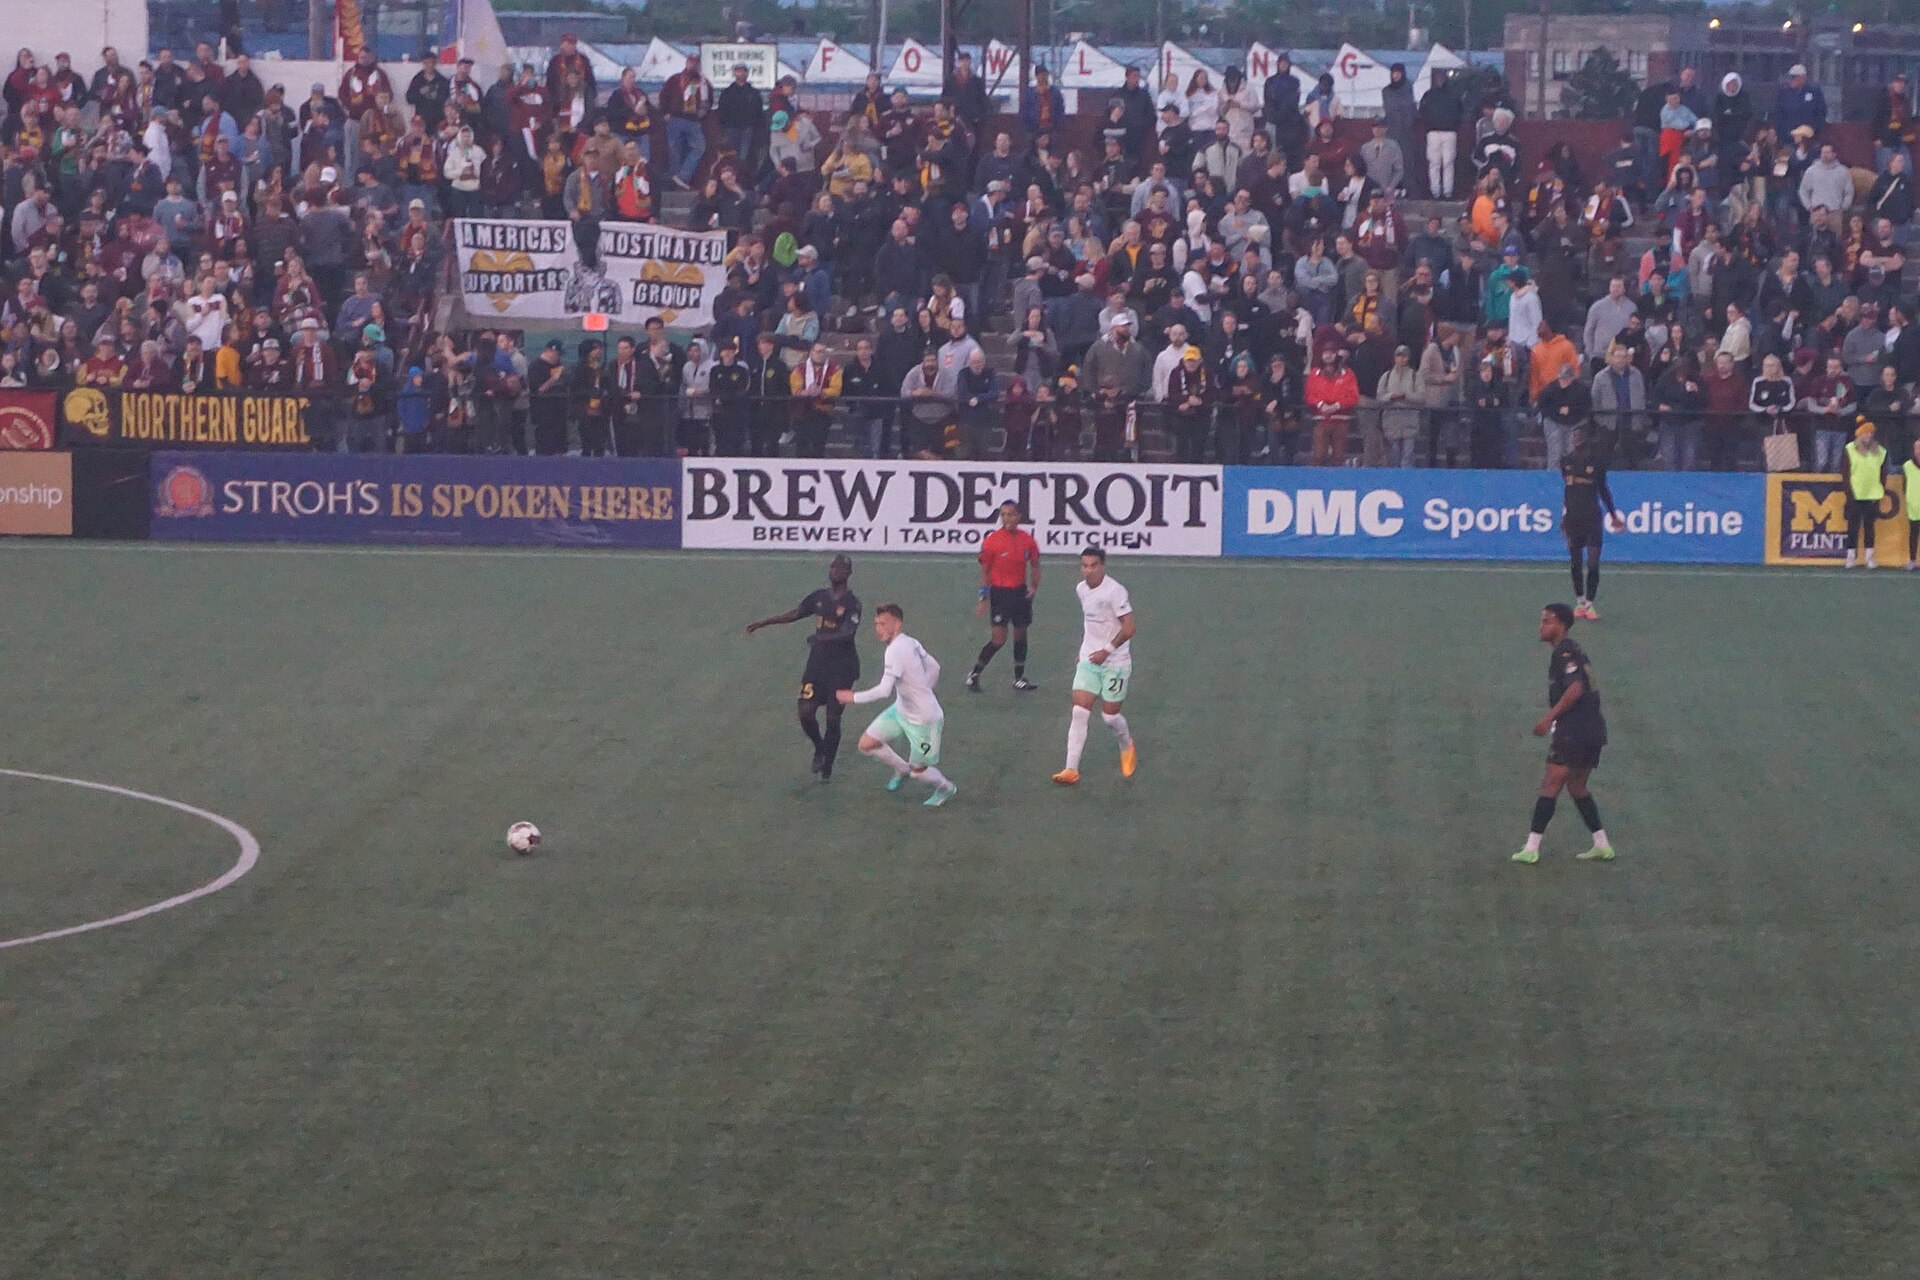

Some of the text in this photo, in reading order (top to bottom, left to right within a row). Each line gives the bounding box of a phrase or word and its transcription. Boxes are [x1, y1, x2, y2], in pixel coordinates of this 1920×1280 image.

[462, 223, 566, 252] AMERICAS
[600, 230, 724, 264] MOST HATED
[633, 282, 700, 307] GROUP
[121, 391, 237, 442] NORTHERN
[222, 479, 674, 521] STROH'S IS SPOKEN HERE
[686, 467, 1218, 529] BREW DETROIT
[1790, 489, 1849, 533] M
[1246, 488, 1743, 540] DMC Sports edicine
[753, 526, 1152, 547] BREWERY TAPRO KITCHEN
[1790, 532, 1849, 550] FLINT
[1108, 677, 1125, 693] 21
[920, 742, 931, 756] 9
